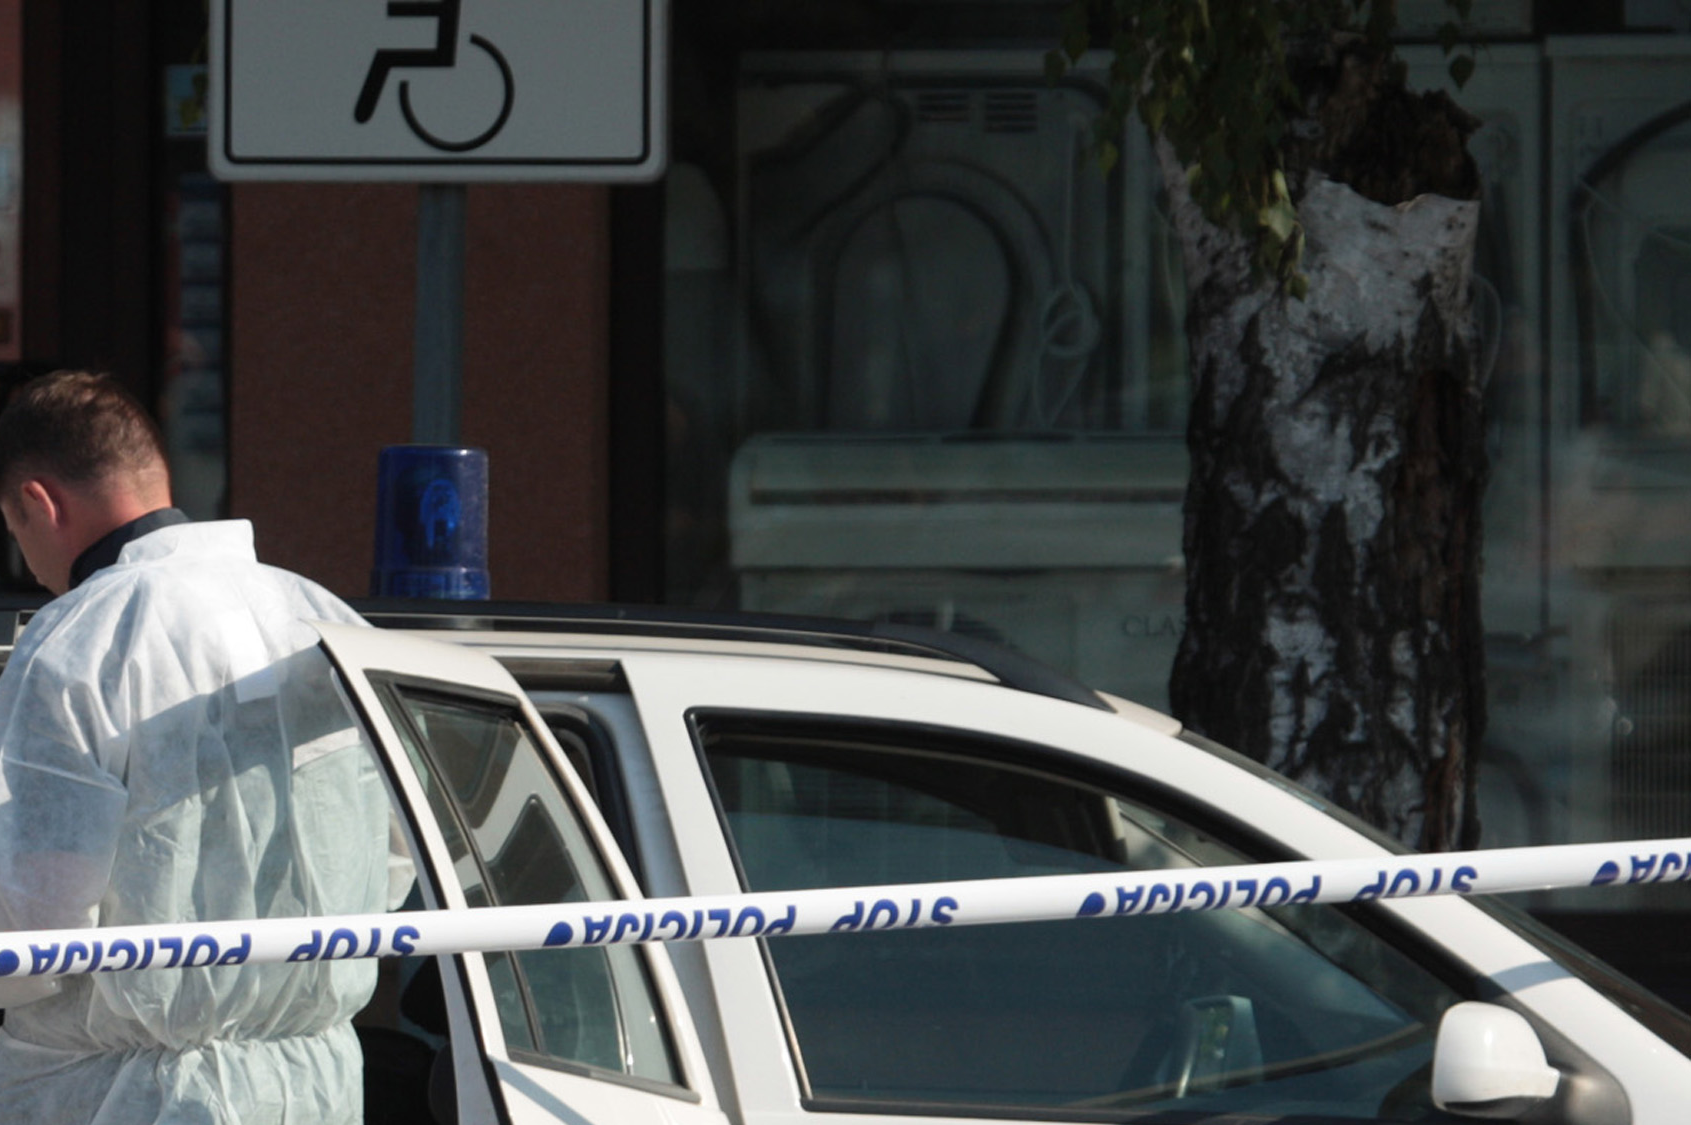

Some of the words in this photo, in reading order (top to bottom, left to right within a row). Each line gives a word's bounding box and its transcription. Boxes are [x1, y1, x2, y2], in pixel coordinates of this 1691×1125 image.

[1110, 874, 1321, 917] POLICIJA
[1356, 865, 1478, 897] STOP
[580, 904, 797, 947] POLICIJA
[830, 896, 959, 932] STOP
[26, 932, 253, 976] POLICIJA
[288, 923, 422, 962] STOP
